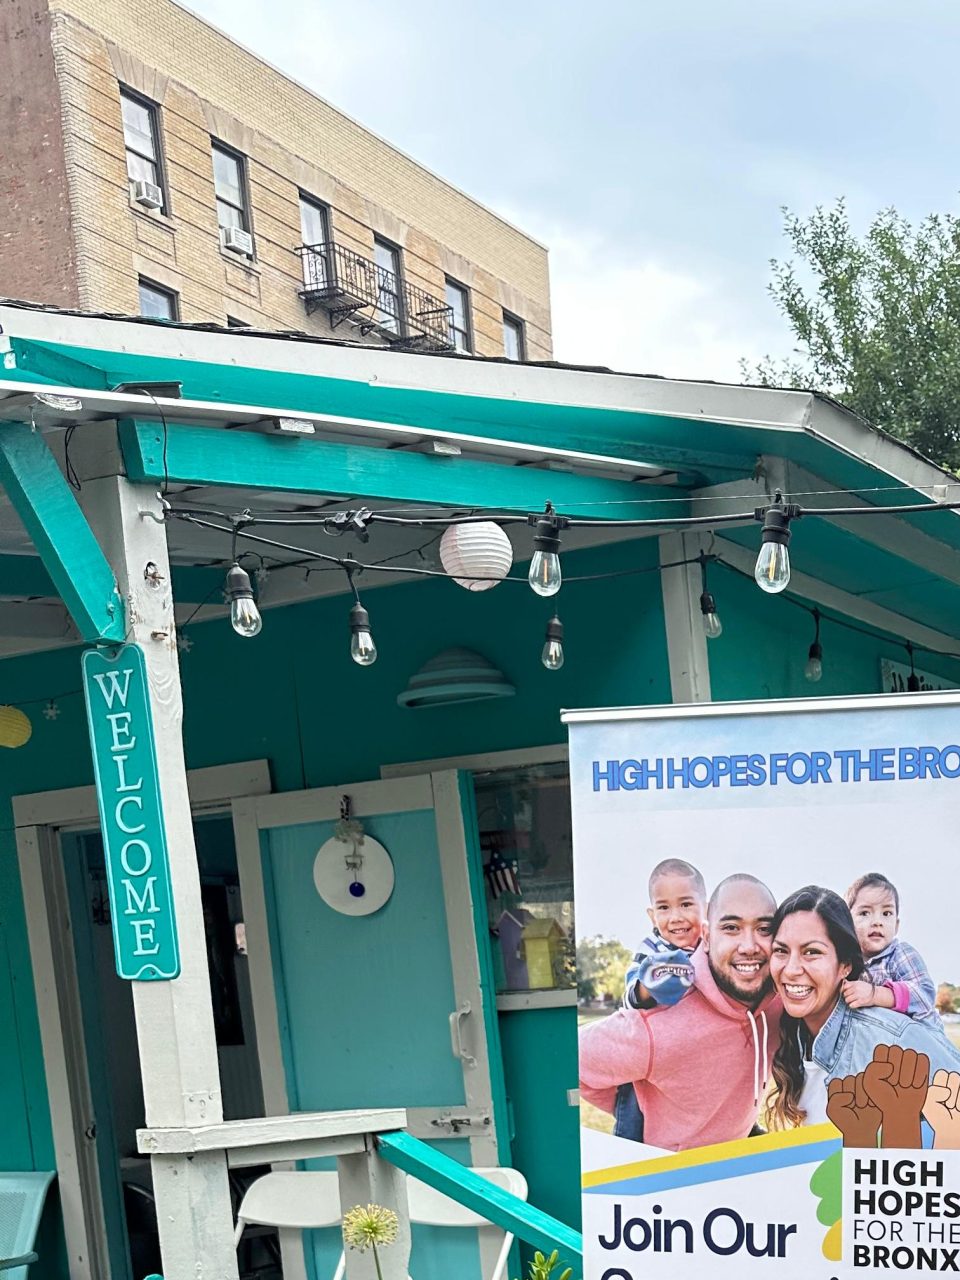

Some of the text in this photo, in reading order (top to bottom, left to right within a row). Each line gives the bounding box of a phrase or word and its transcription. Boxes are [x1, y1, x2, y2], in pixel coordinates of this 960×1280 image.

[592, 758, 664, 792] HIGH
[667, 753, 767, 789] HOPES
[770, 751, 833, 785] FOR
[834, 748, 895, 782] THE
[93, 668, 160, 956] WELCOME
[854, 1158, 944, 1187] HIGH
[597, 1204, 798, 1258] Join Our
[853, 1219, 904, 1242] FOR
[853, 1244, 960, 1272] BRONX
